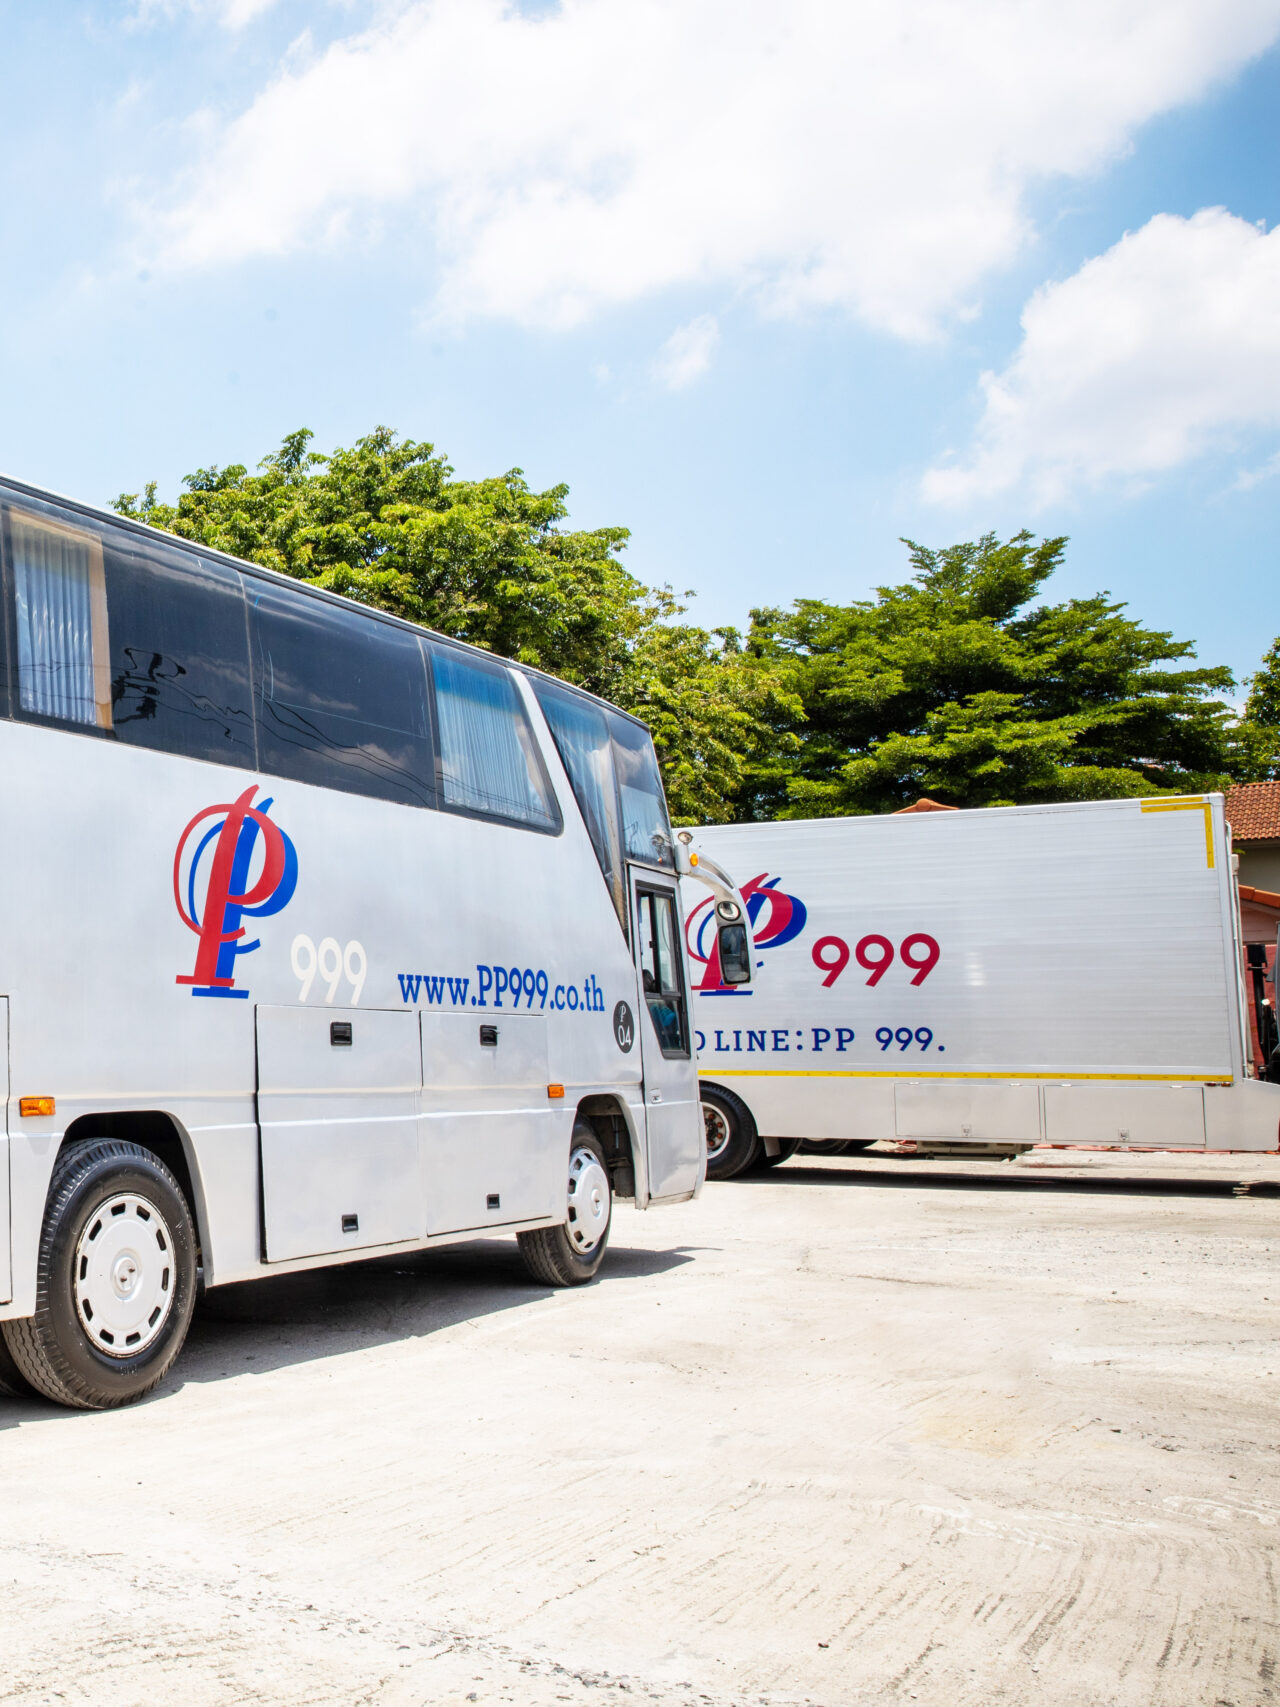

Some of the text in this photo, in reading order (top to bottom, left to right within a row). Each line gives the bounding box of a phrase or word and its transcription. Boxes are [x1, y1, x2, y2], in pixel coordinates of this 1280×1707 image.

[290, 933, 368, 1006] 999
[811, 932, 941, 989] 999
[397, 964, 605, 1012] www.PP999.co.th
[617, 1025, 632, 1046] 04
[875, 1026, 946, 1052] 999.
